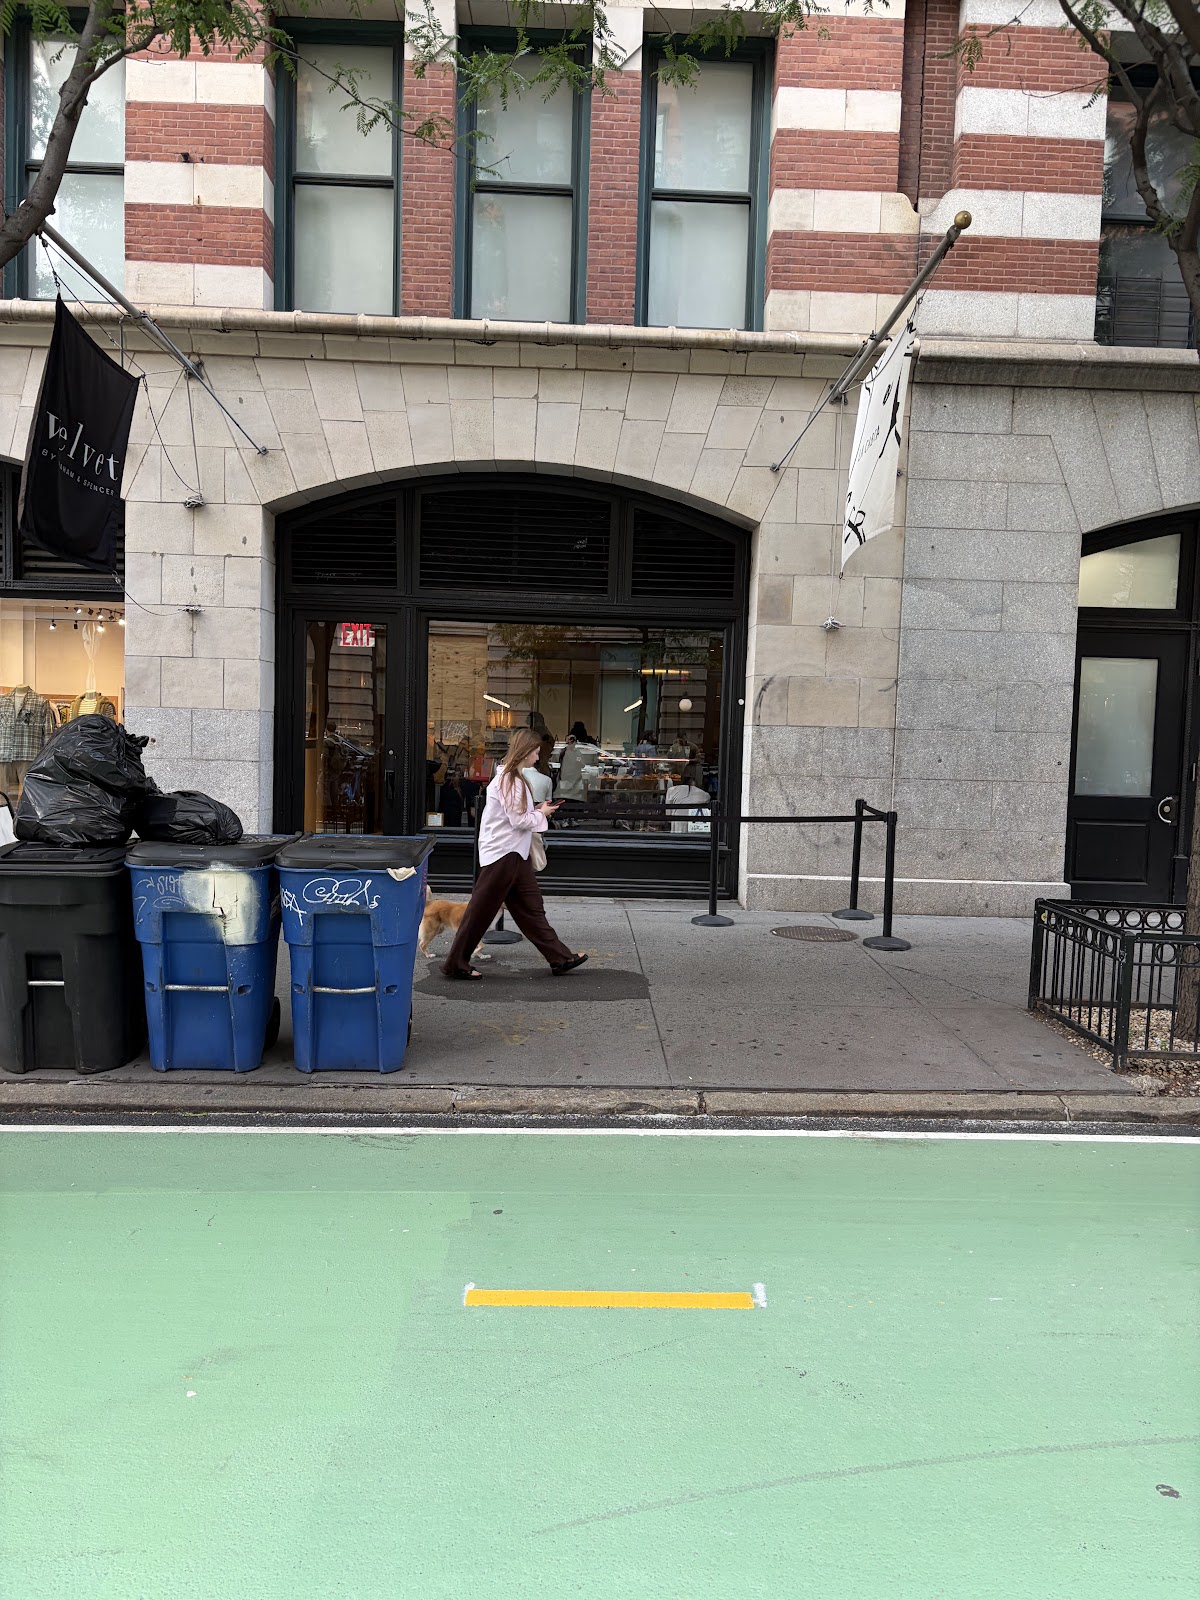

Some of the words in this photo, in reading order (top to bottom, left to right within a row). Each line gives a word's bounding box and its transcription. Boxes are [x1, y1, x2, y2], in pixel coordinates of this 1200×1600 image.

[46, 411, 120, 481] Velvet
[41, 448, 57, 460] BY
[59, 461, 75, 479] AHAM
[82, 479, 115, 497] SPENCER
[341, 623, 372, 647] EXIT
